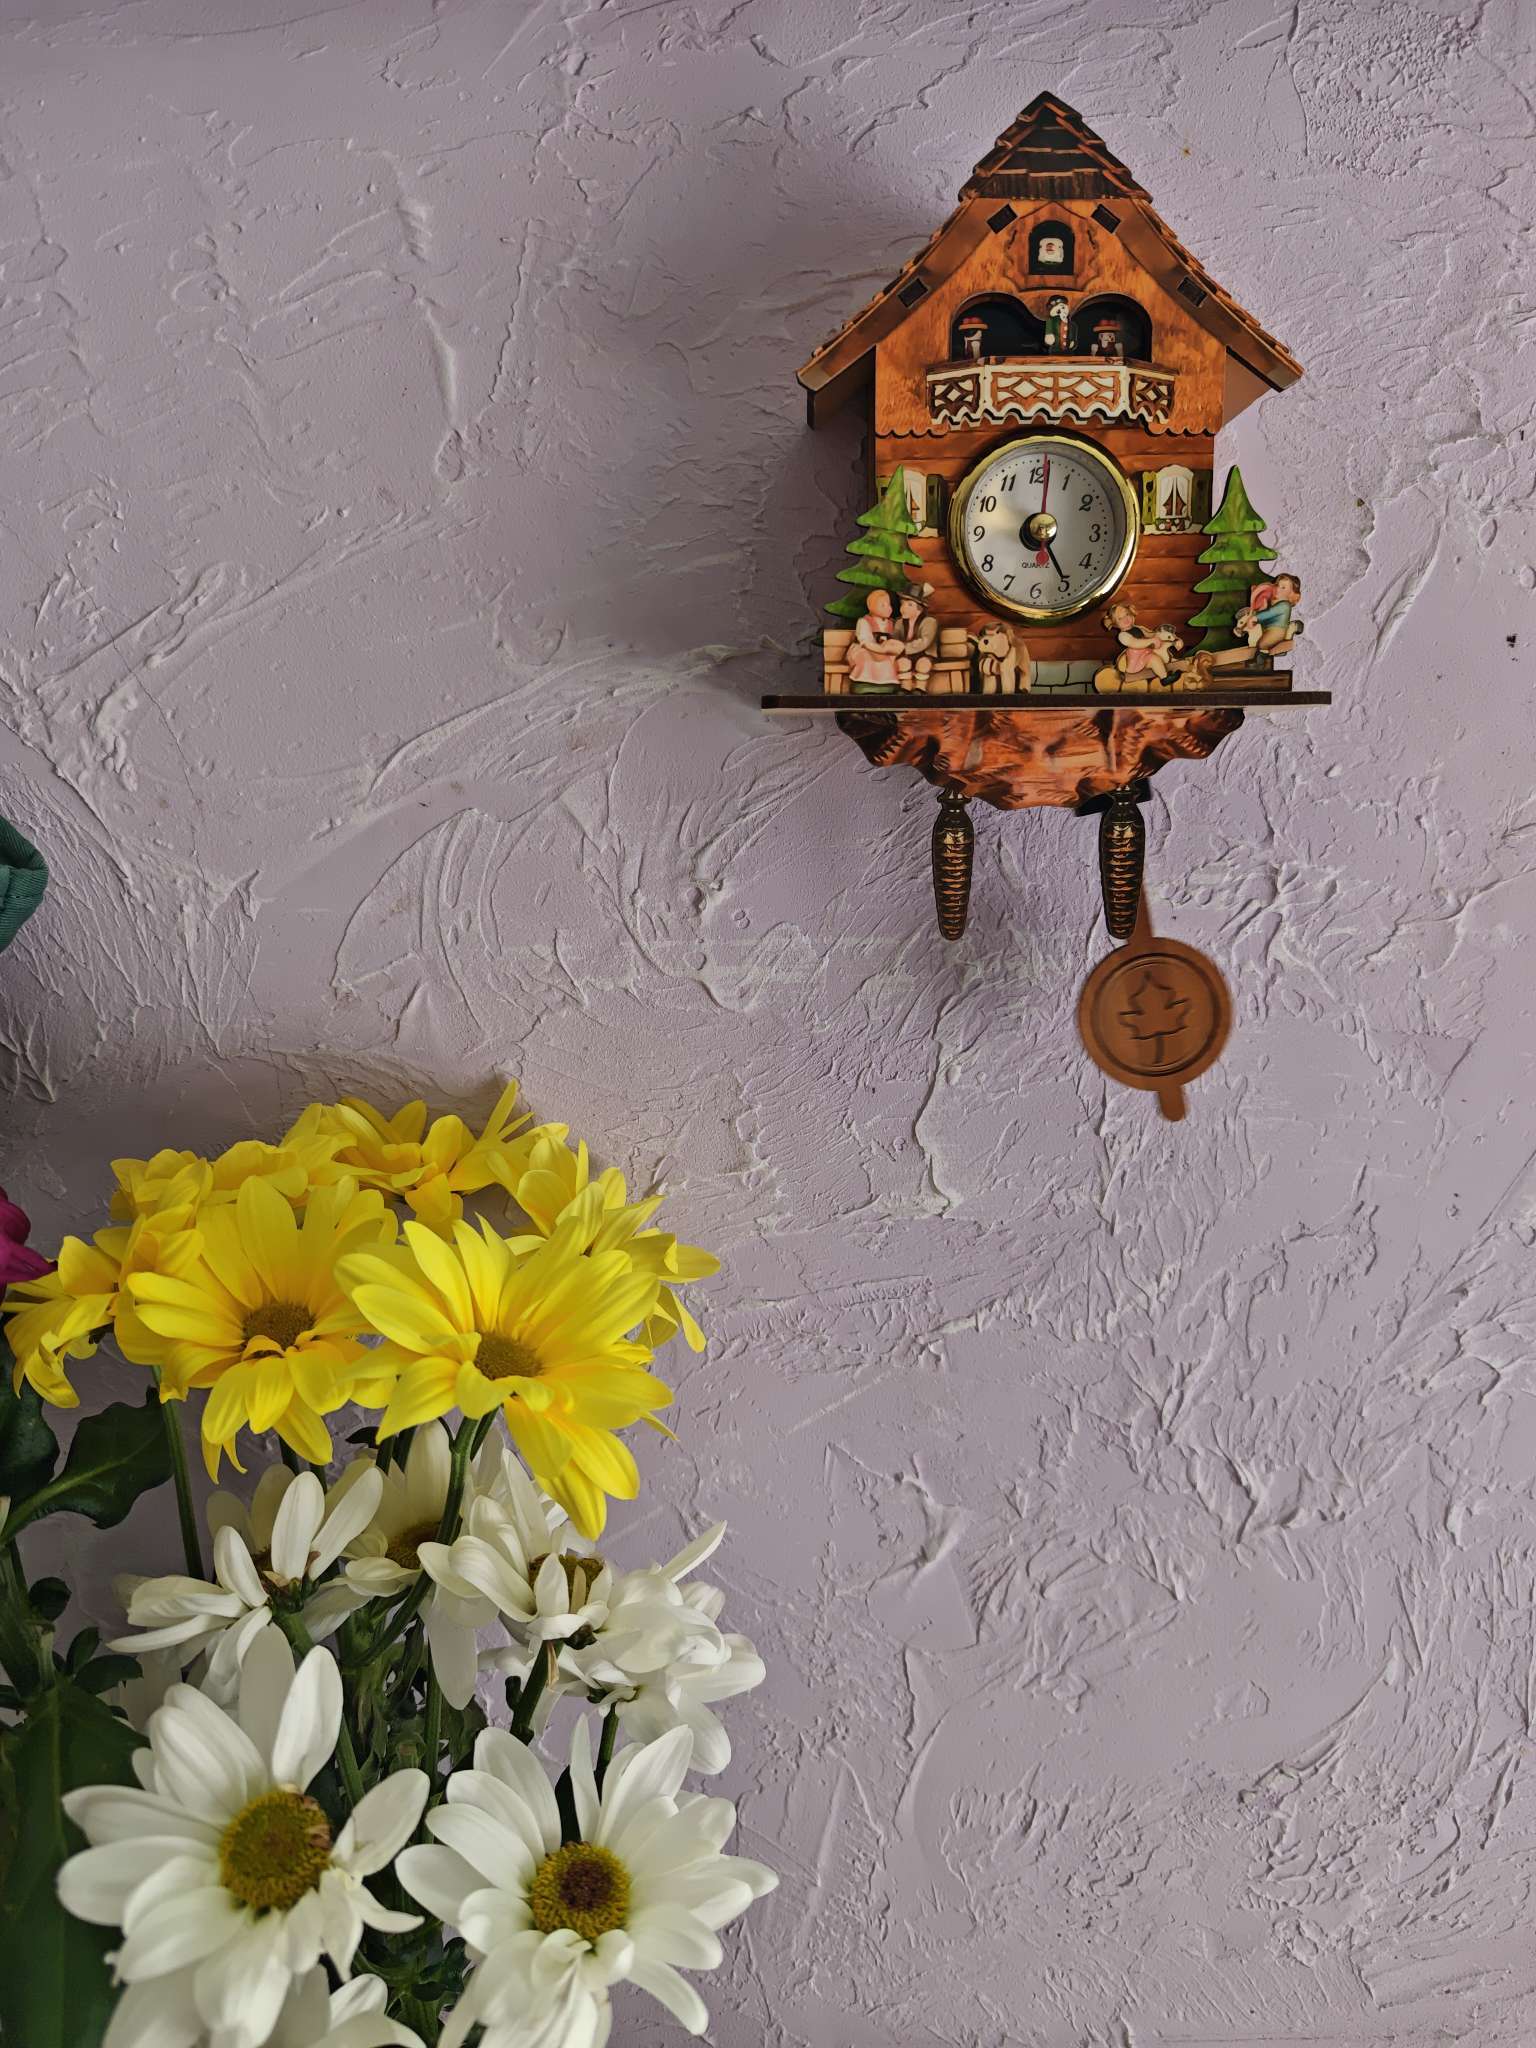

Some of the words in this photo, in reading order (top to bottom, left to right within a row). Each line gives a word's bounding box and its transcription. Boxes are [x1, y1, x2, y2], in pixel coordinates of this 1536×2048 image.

[1000, 474, 1017, 492] 11
[1028, 466, 1045, 484] 12
[1061, 474, 1071, 491] 1
[979, 495, 997, 513] 10
[1078, 494, 1093, 512] 2
[973, 525, 985, 542] 9
[1089, 523, 1101, 542] 3
[981, 554, 994, 572] 8
[1078, 552, 1092, 570] 4
[1003, 574, 1016, 591] 7
[1029, 582, 1042, 599] 6
[1057, 575, 1070, 592] 5
